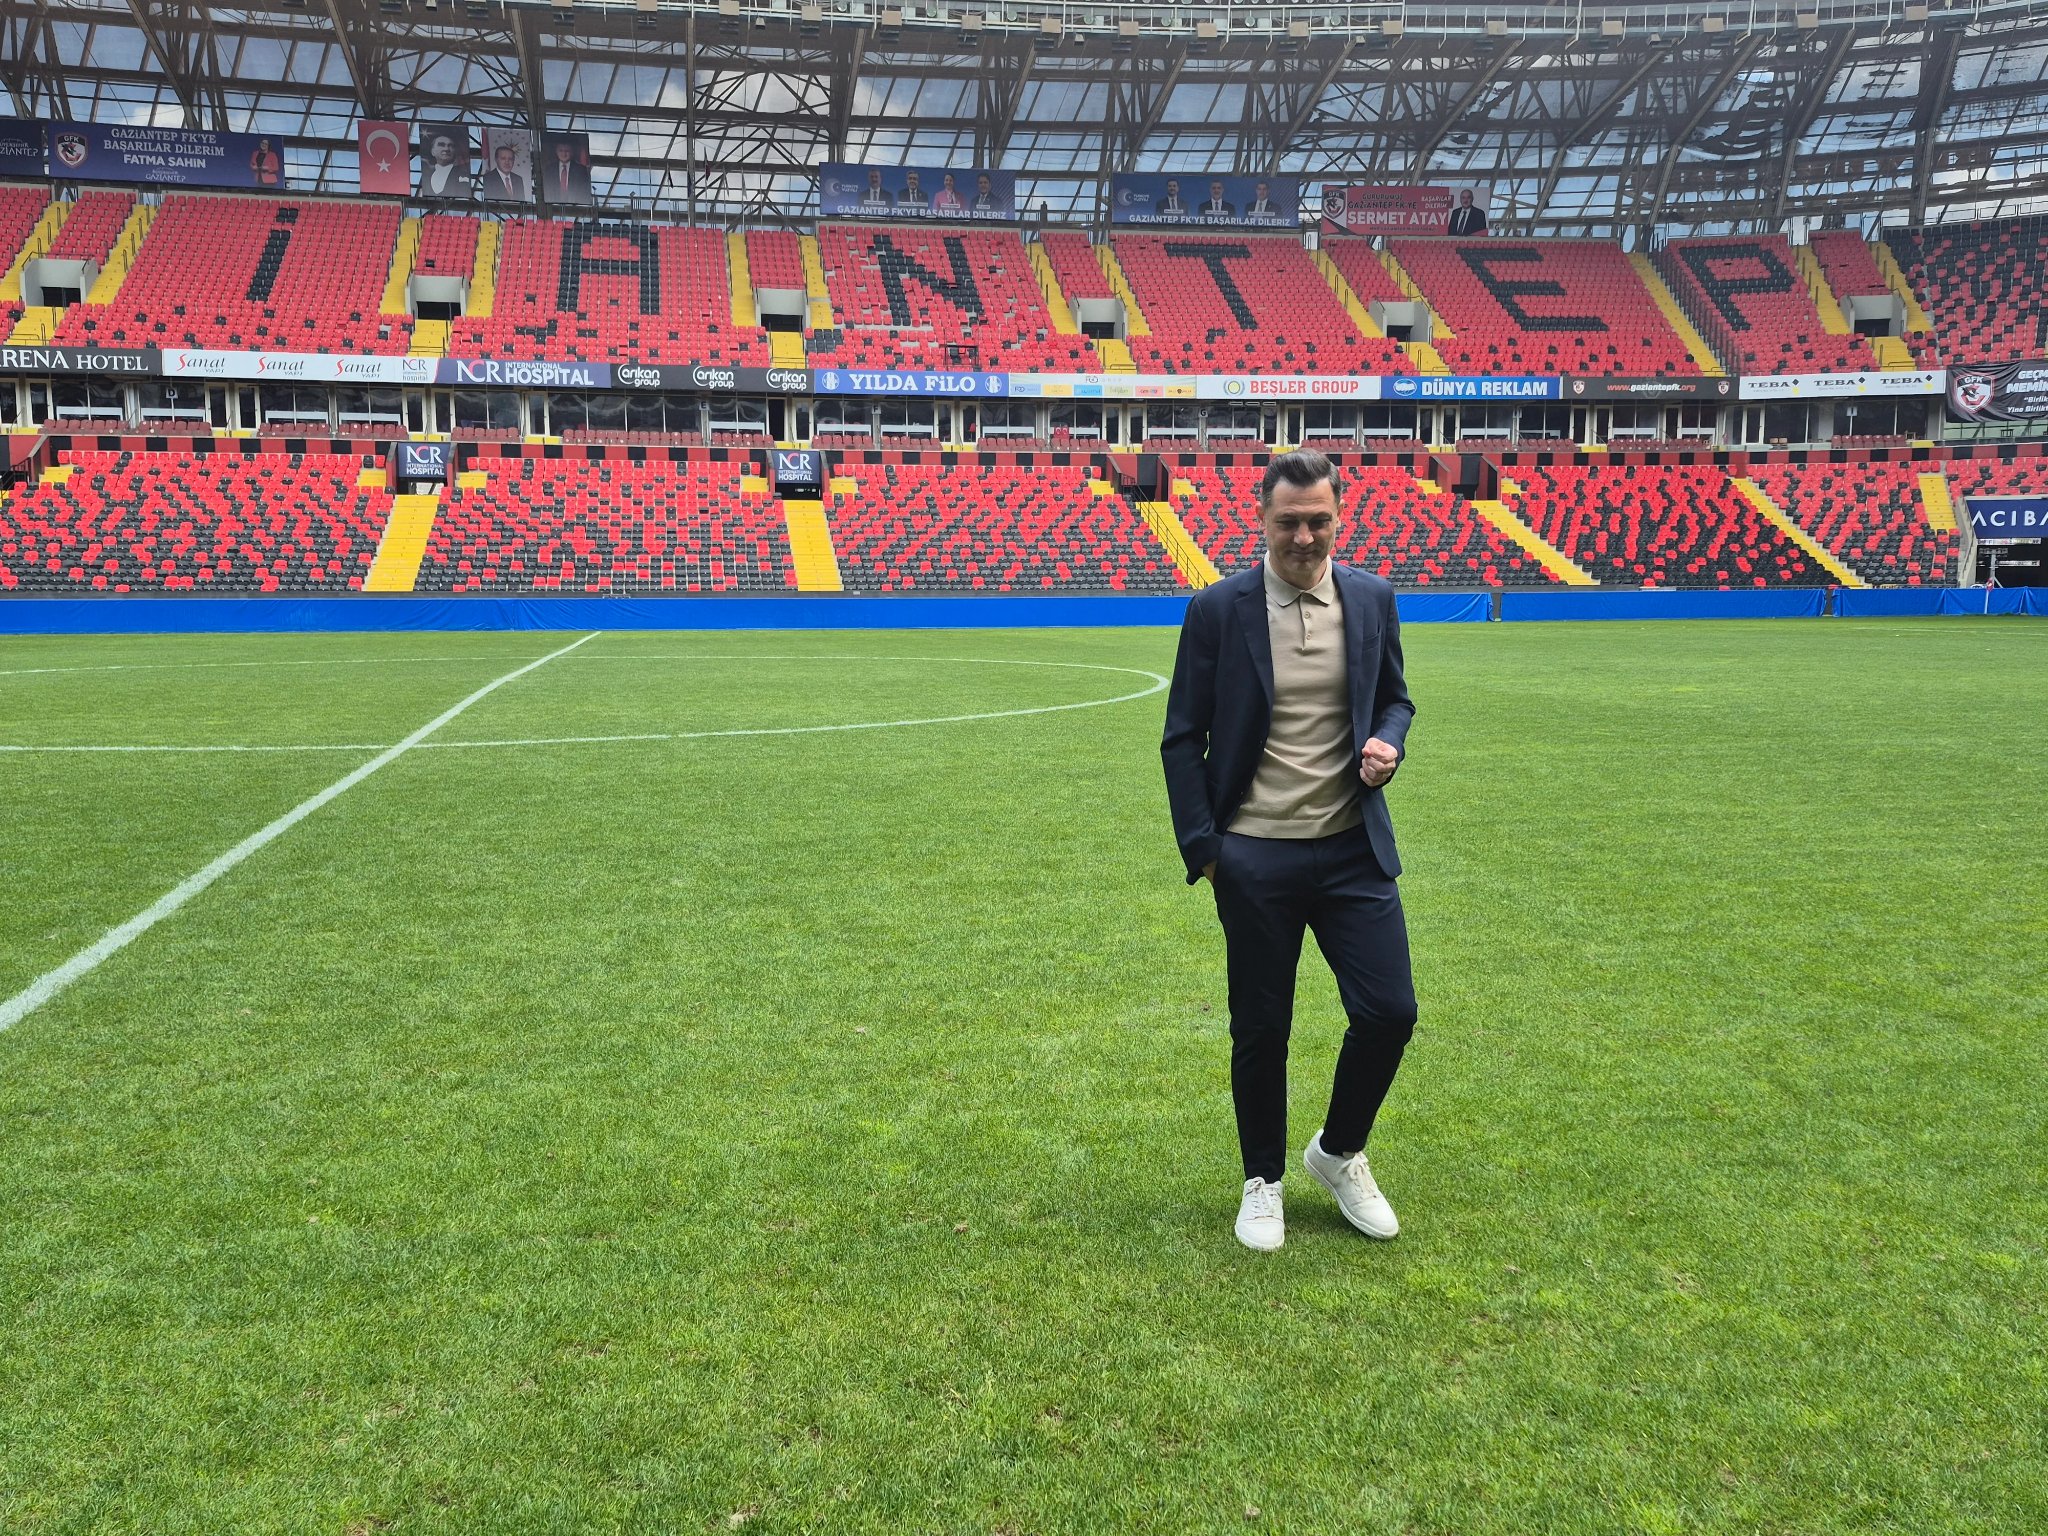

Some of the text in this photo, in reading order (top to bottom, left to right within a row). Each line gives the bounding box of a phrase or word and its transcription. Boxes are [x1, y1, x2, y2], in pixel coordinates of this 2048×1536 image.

[181, 132, 217, 144] FK'YE
[103, 140, 171, 153] BAŞARILAR
[123, 154, 165, 166] FATMA
[891, 207, 918, 216] FK'YE
[1180, 216, 1205, 224] FK'YE
[1207, 216, 1256, 226] BAŞARILAR
[1347, 211, 1447, 225] SERMET ATAY
[0, 349, 149, 371] RENA HOTEL
[402, 358, 427, 371] NCR
[505, 362, 562, 370] INTERNATIONAL
[457, 360, 503, 383] NCR
[505, 368, 595, 385] HOSPITAL
[402, 374, 428, 382] hospital
[634, 378, 660, 388] group
[849, 373, 918, 391] YILDA
[1814, 379, 1856, 387] TEBA
[1880, 377, 1923, 385] TEBA
[709, 380, 734, 389] group
[781, 382, 807, 391] group
[1250, 380, 1359, 397] BEŞLER GROUP
[1421, 378, 1548, 396] DÜNYA REKLAM
[1607, 383, 1696, 392] www.gaziantepfk.org
[168, 389, 175, 397] D
[701, 401, 707, 409] E
[1200, 408, 1207, 417] G
[406, 445, 444, 464] NCR
[778, 452, 813, 470] NCR
[406, 467, 445, 476] HOSPITAL
